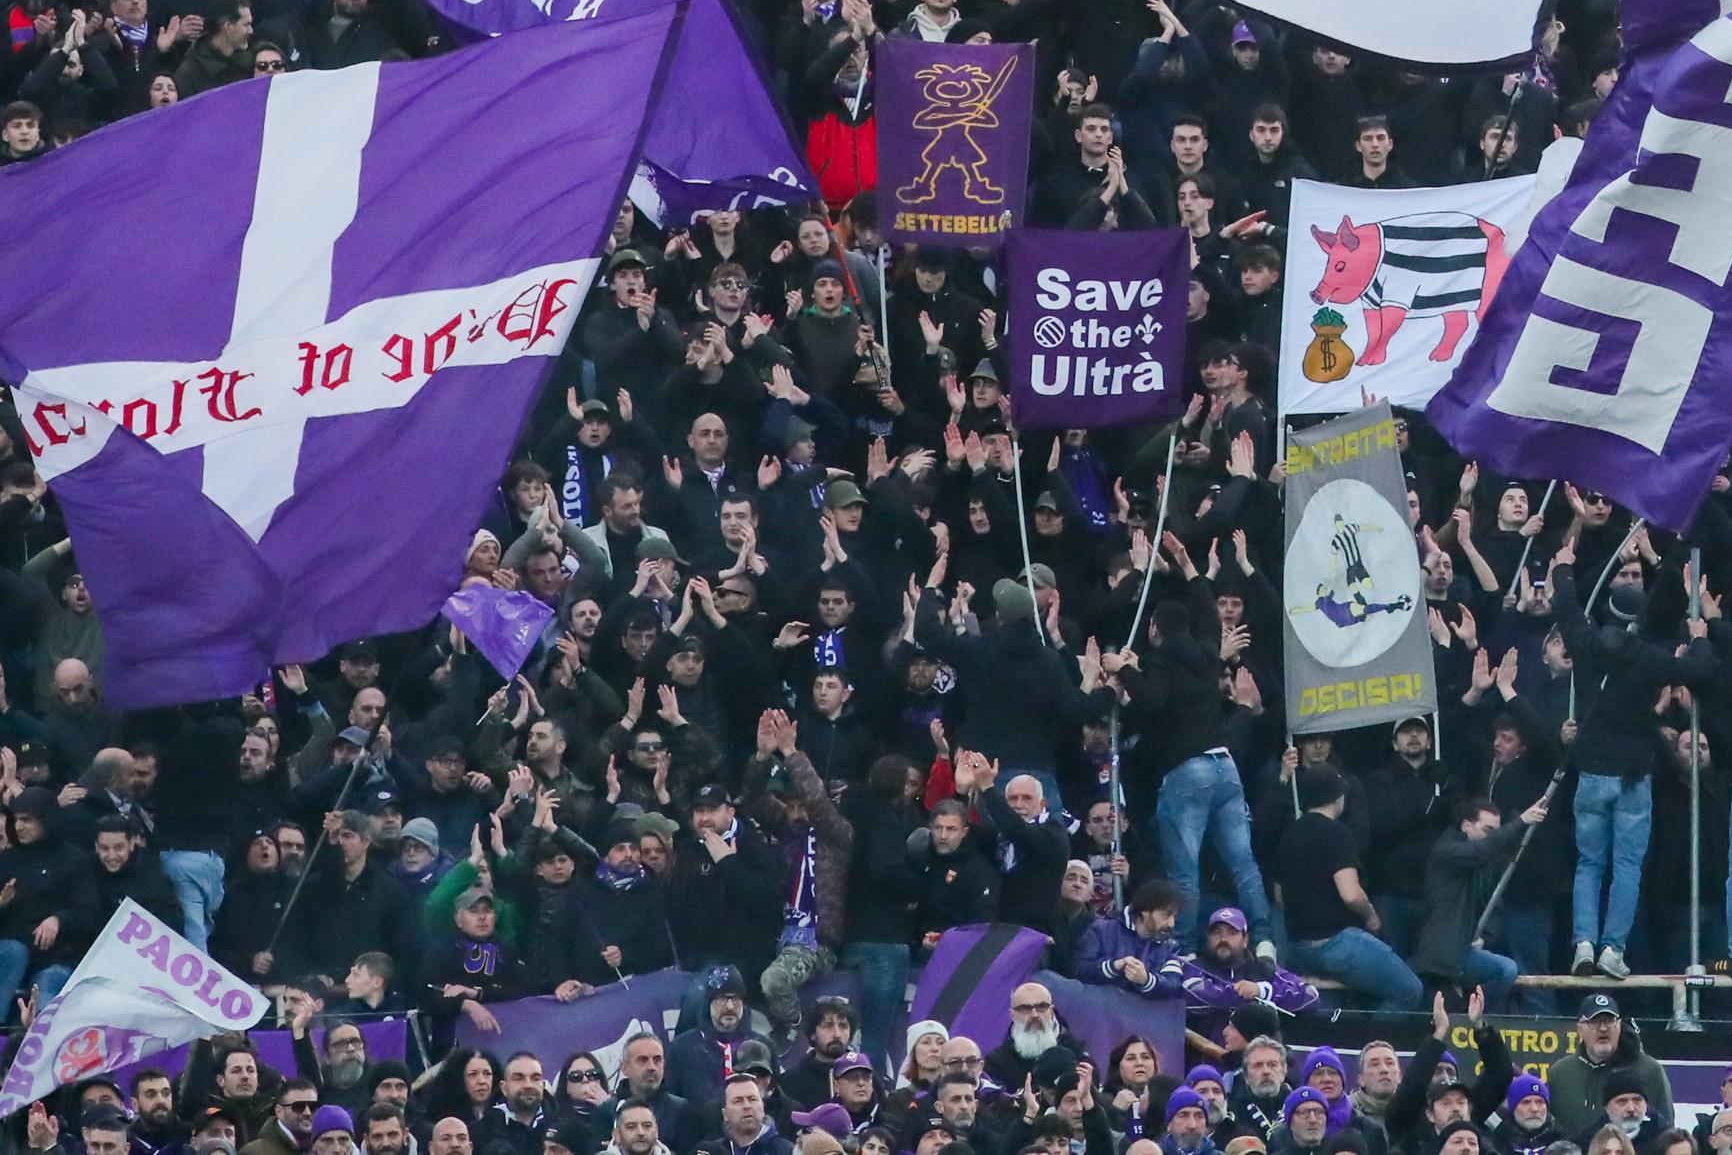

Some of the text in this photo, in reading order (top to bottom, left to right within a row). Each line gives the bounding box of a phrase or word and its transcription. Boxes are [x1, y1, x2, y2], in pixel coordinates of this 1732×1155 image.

[1036, 268, 1163, 311] Save
[1070, 319, 1132, 348] the
[1030, 352, 1165, 397] Ultrà
[1286, 419, 1396, 475] ENTRATA
[116, 911, 254, 1021] PAOLO
[1451, 1026, 1559, 1054] CTRO
